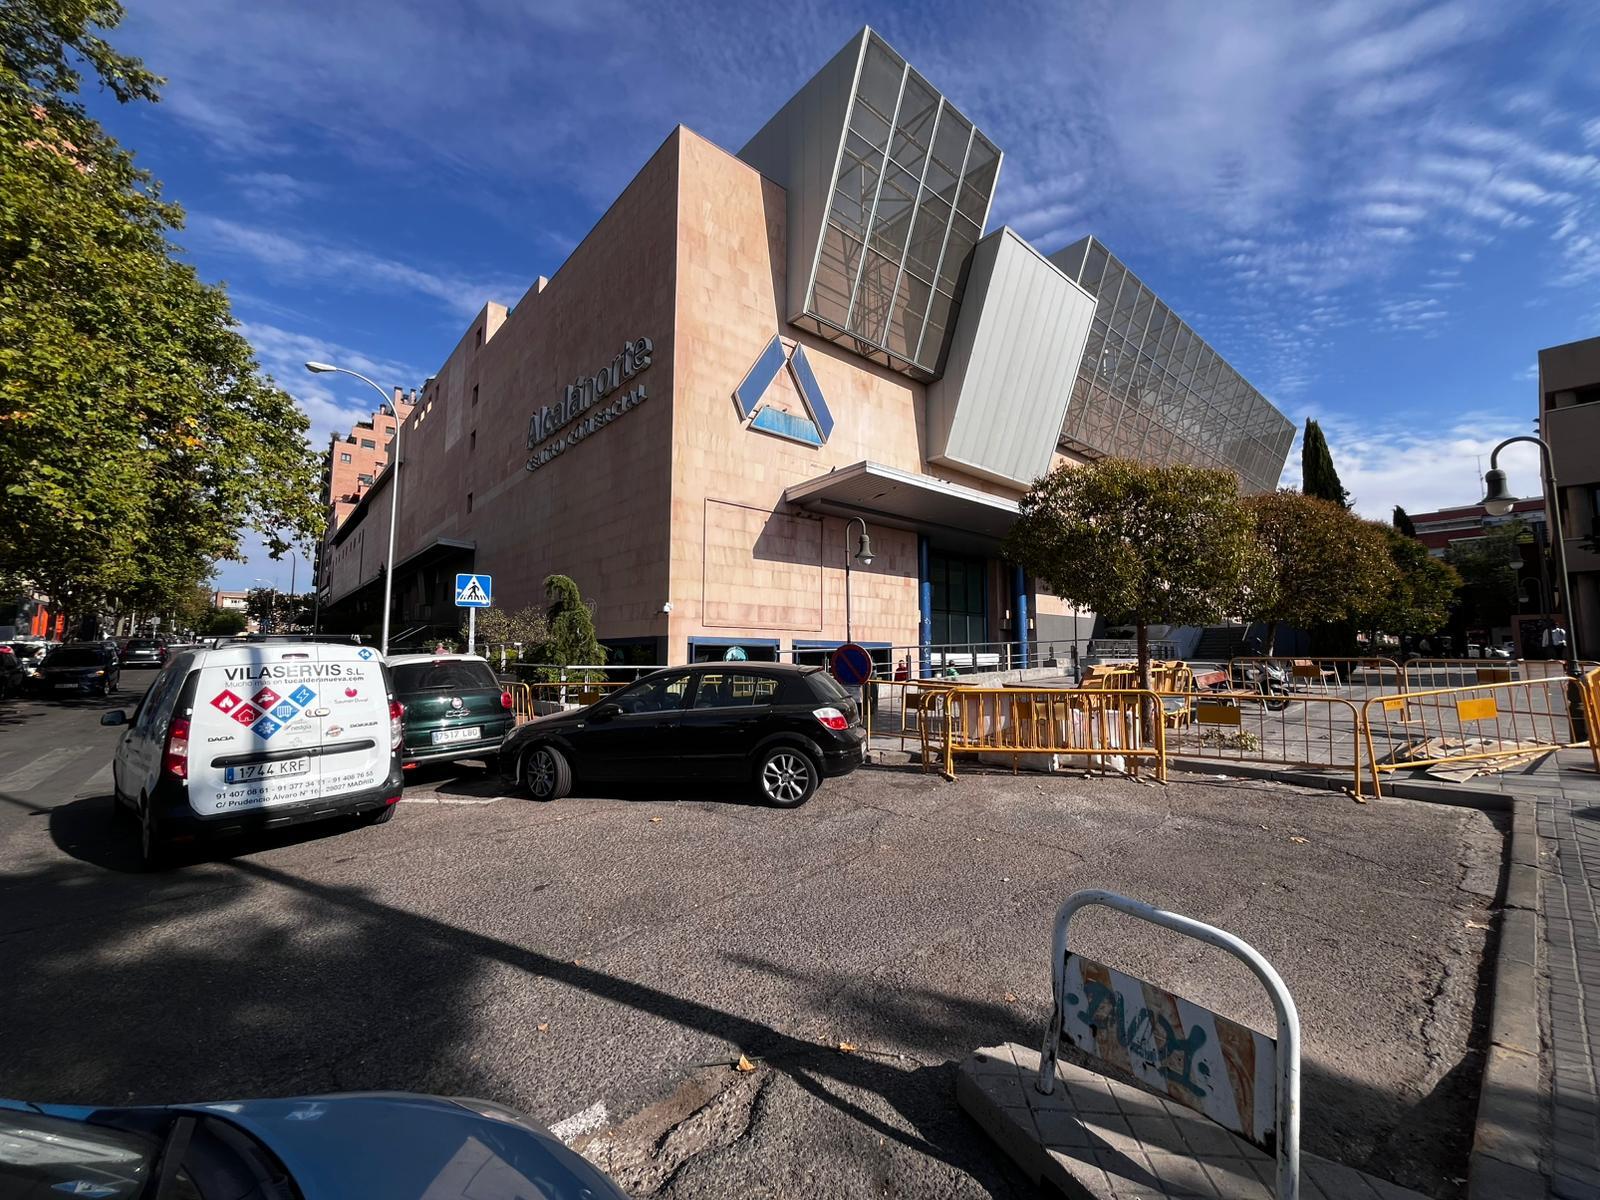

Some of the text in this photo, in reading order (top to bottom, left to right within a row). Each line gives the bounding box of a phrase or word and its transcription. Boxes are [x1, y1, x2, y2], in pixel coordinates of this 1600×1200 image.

[224, 664, 364, 681] VILASERVIS S.L.
[439, 731, 460, 740] 7517
[239, 760, 306, 778] 1744 KRF
[216, 792, 226, 800] 91
[229, 789, 245, 798] 407
[289, 782, 303, 790] 377
[228, 796, 270, 807] Prudencio
[347, 778, 375, 788] MADRID
